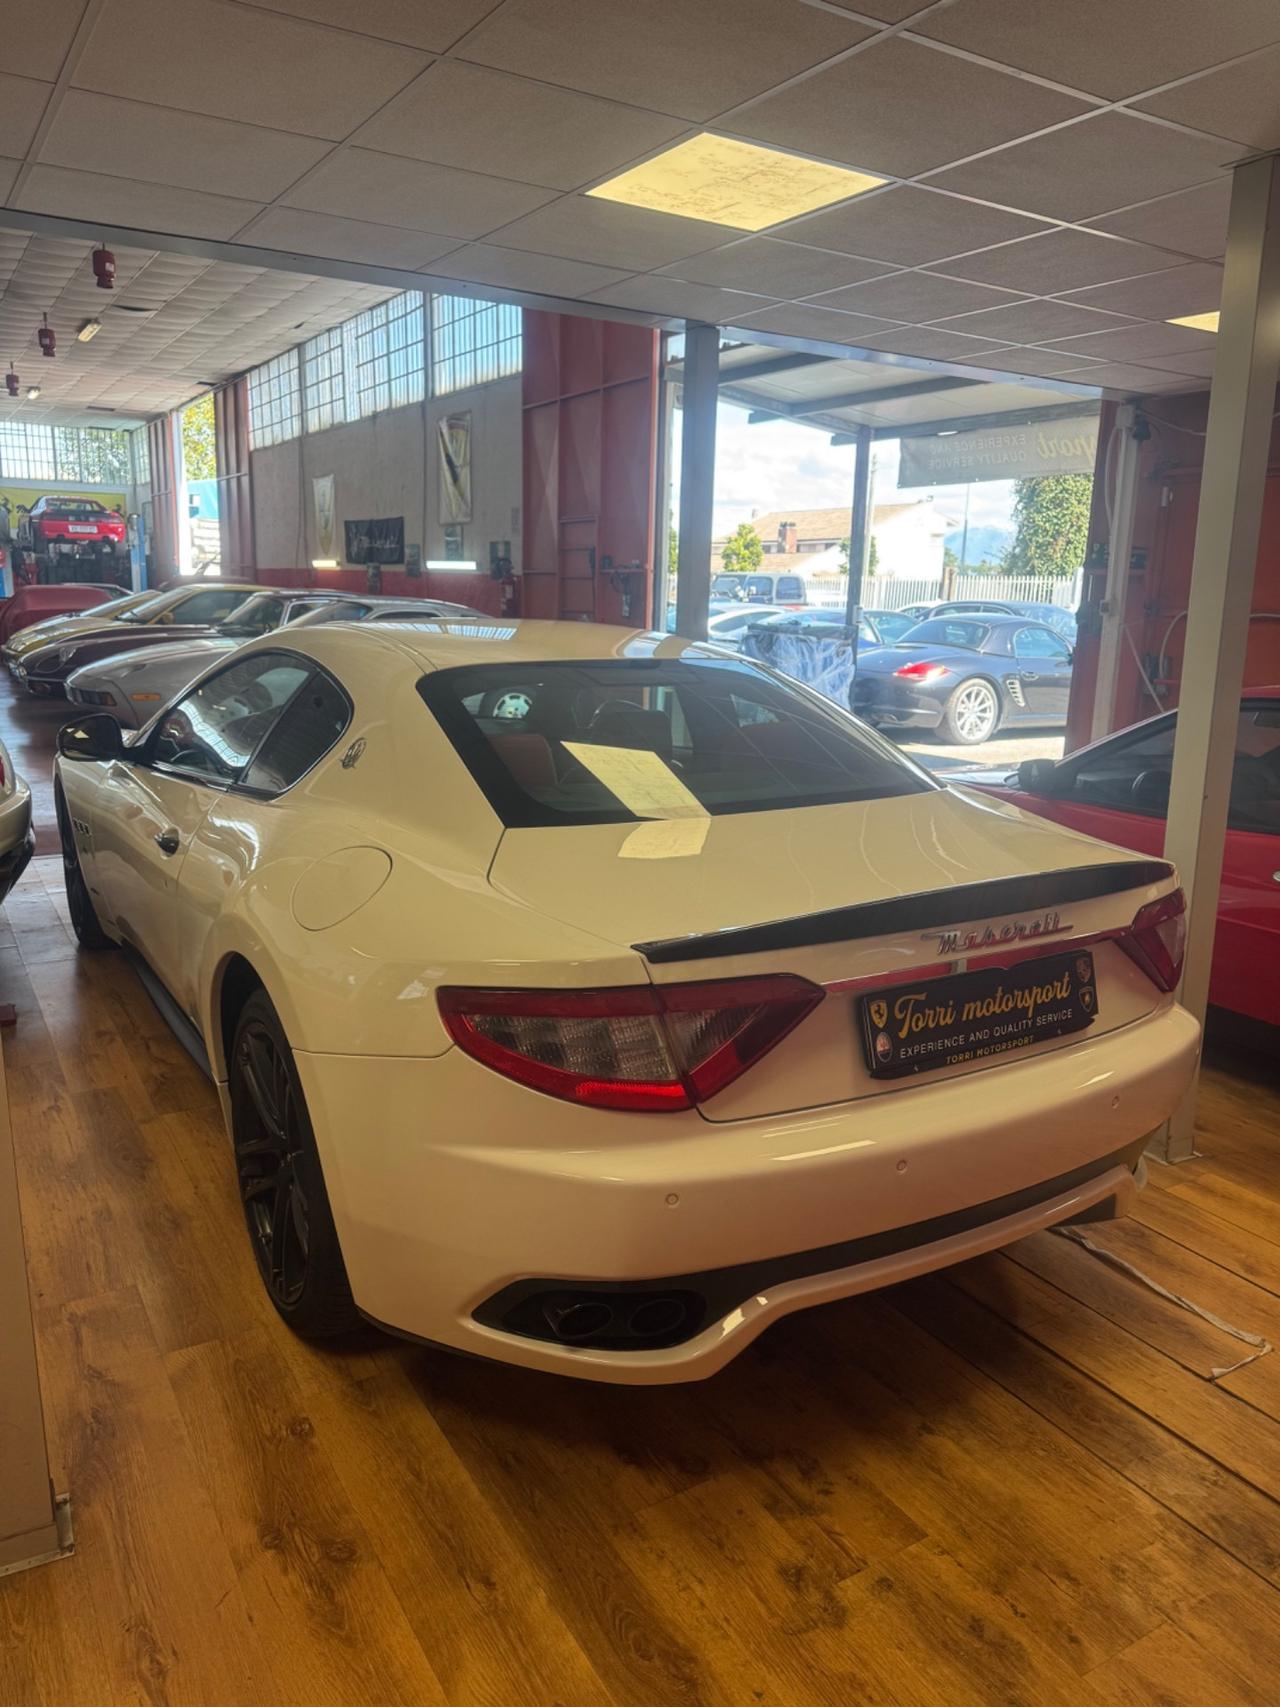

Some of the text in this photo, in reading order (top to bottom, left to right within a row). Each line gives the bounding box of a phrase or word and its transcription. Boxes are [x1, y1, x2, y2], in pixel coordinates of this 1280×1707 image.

[894, 972, 1071, 1039] Torri motorsport
[900, 1009, 1072, 1059] EXPERIENCE AND QUALITY SERVICE
[945, 1036, 1035, 1065] TORRI MOTORSPORT
